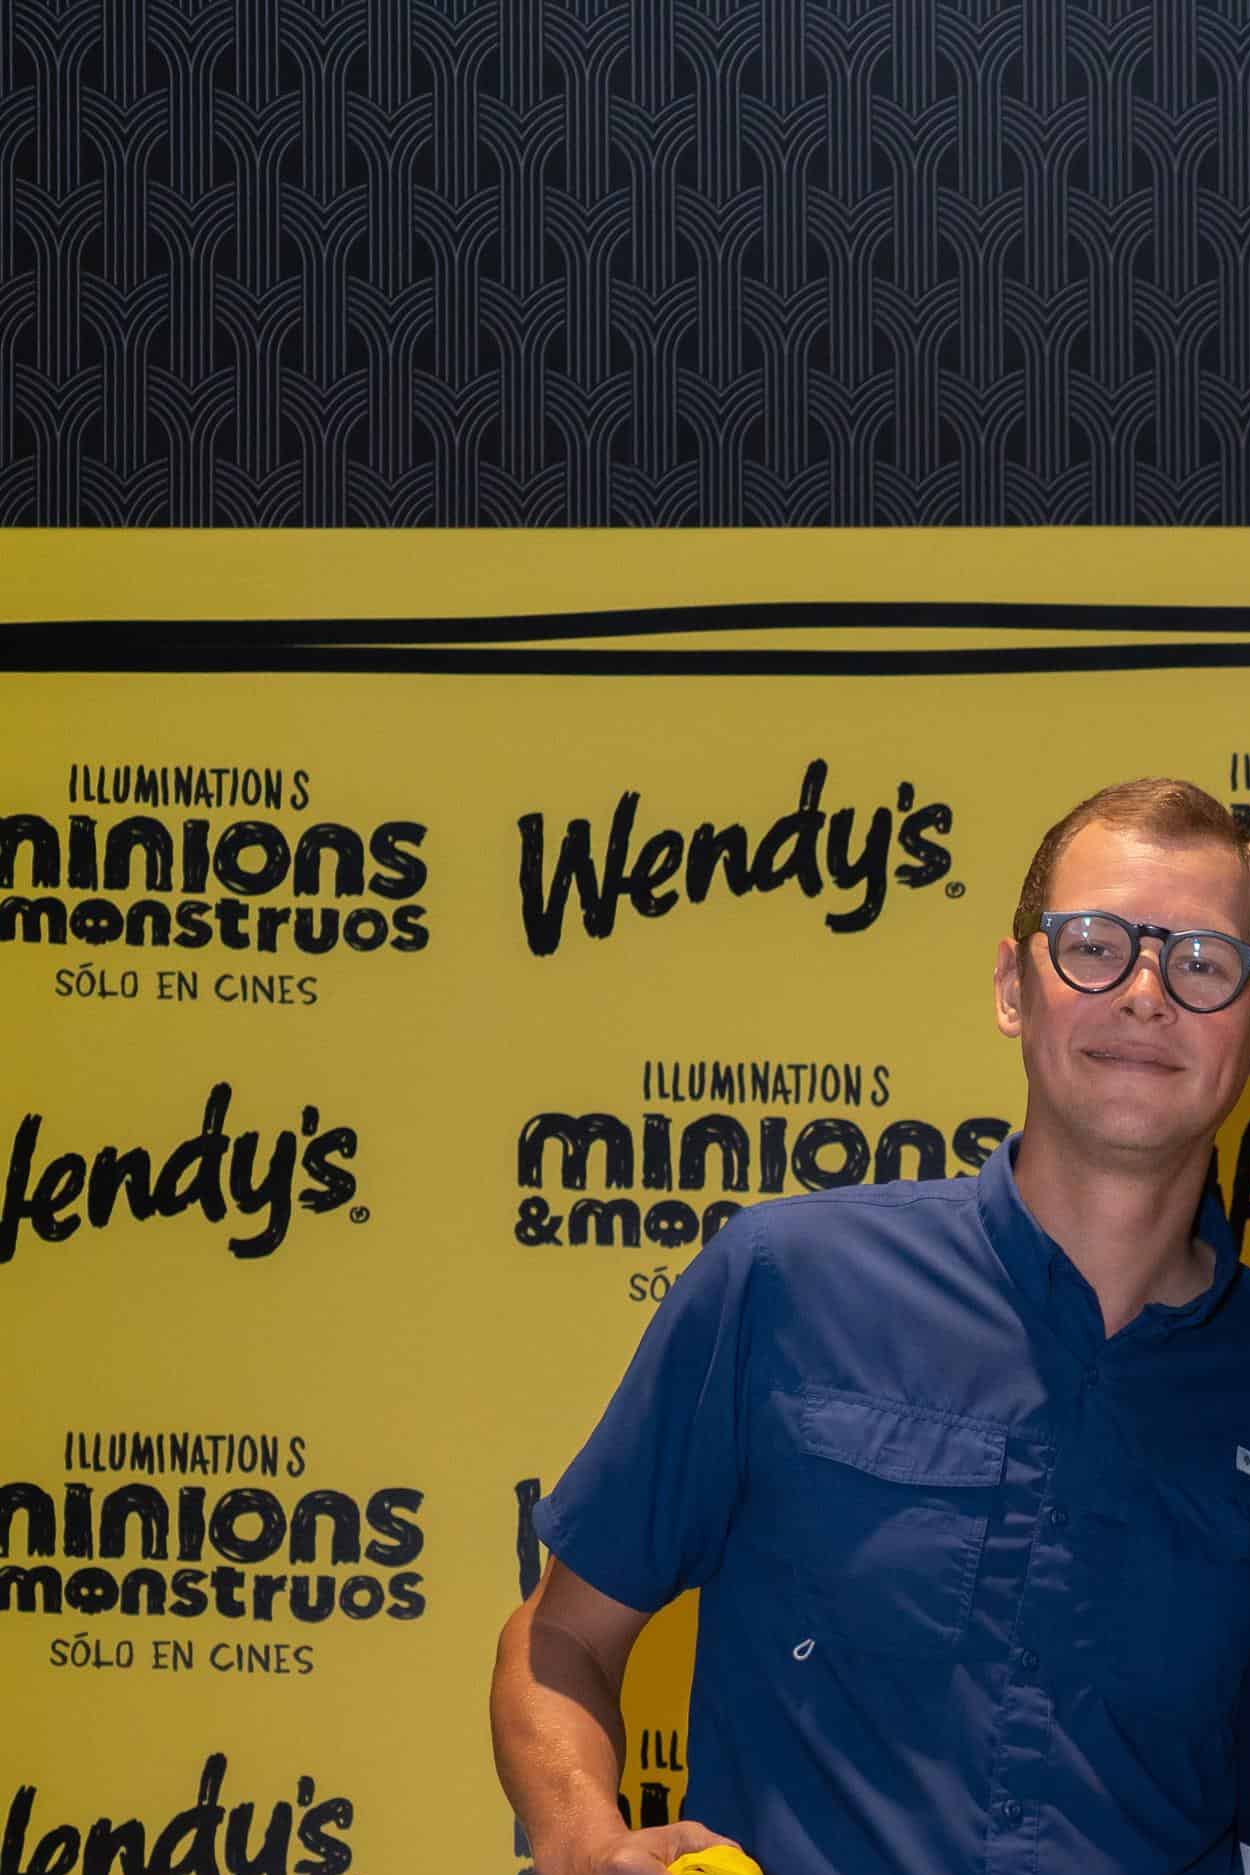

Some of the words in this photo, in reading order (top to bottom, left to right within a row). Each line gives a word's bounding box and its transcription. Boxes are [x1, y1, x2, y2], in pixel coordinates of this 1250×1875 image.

[69, 764, 310, 810] ILLUMINATIONS
[0, 895, 430, 955] monstruos
[55, 962, 139, 999] SÓLO
[158, 971, 198, 1001] EN
[214, 974, 318, 1005] CINES
[643, 1061, 891, 1107] ILLUMINATIONS
[64, 1431, 306, 1478] ILLUMINATIONS
[0, 1565, 426, 1624] monstruos
[50, 1632, 134, 1669] SÓLO
[152, 1640, 193, 1671] EN
[209, 1643, 313, 1674] CINES
